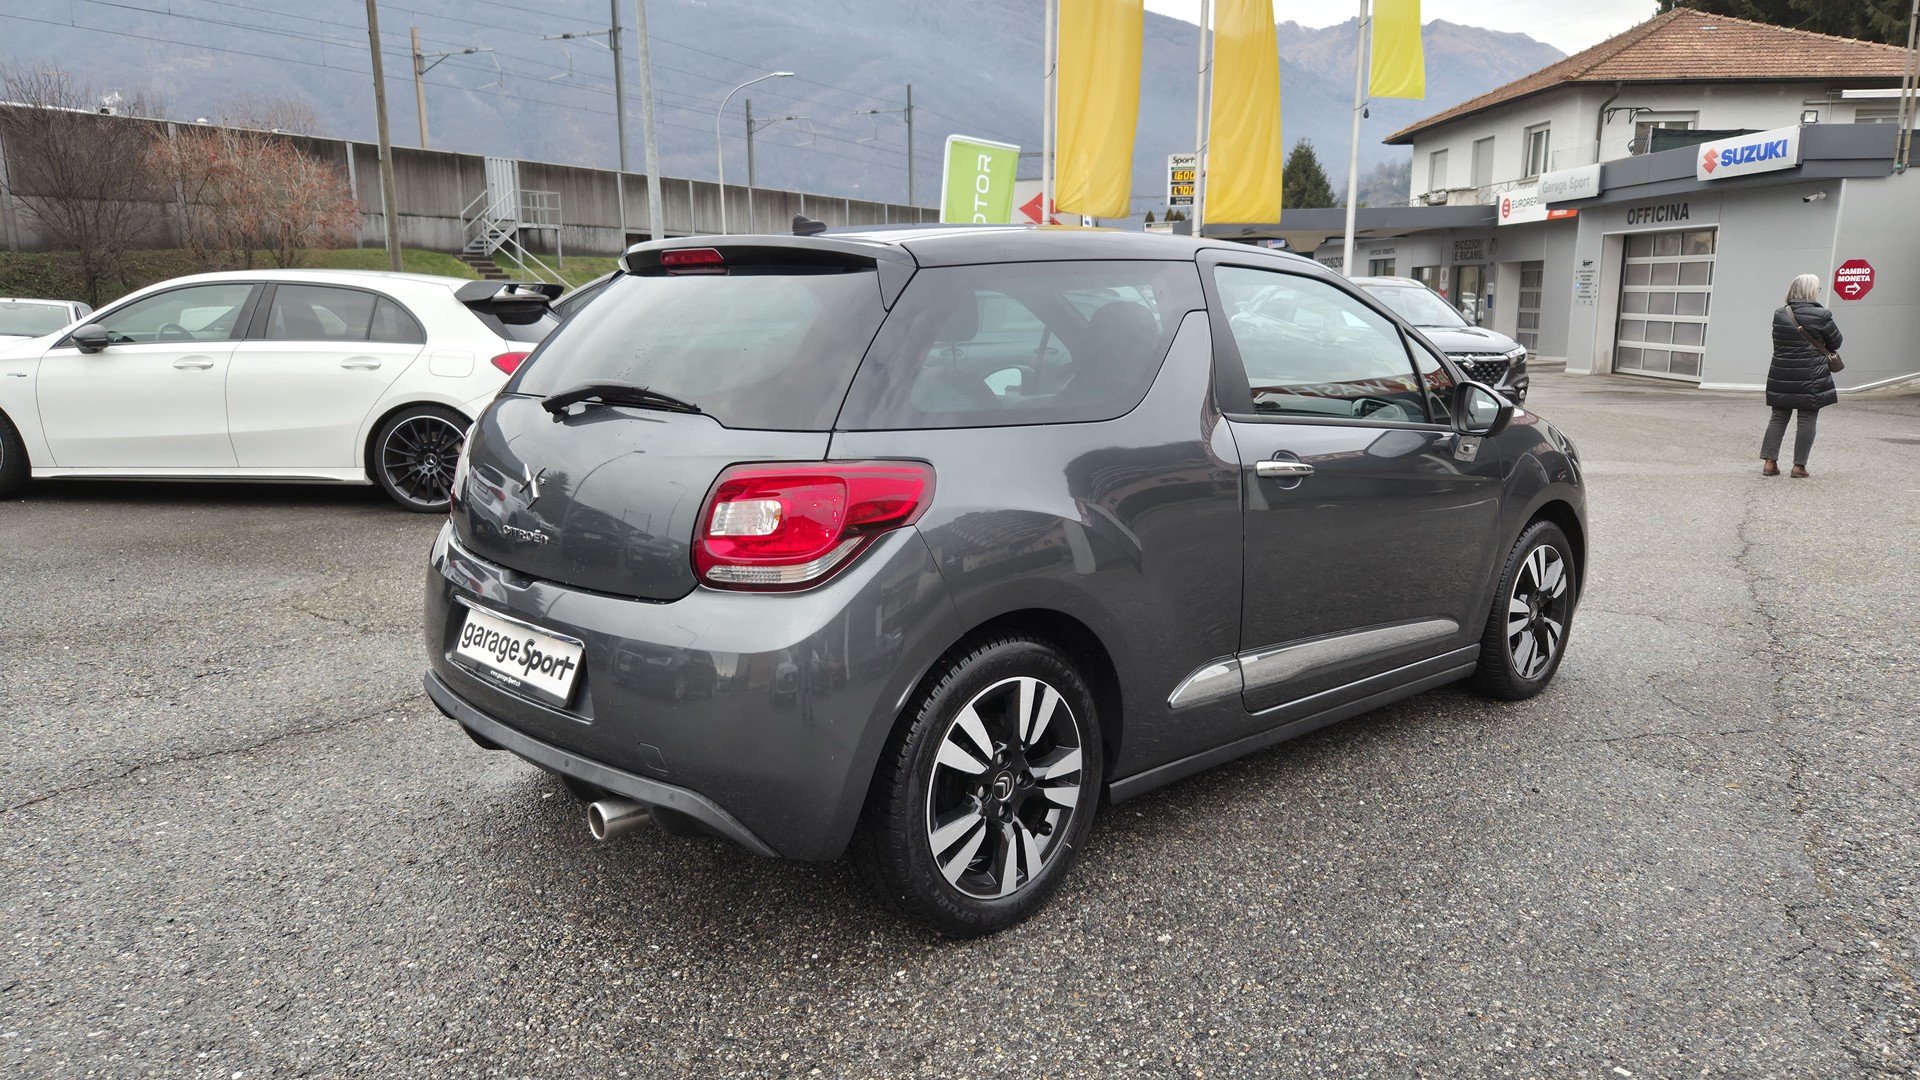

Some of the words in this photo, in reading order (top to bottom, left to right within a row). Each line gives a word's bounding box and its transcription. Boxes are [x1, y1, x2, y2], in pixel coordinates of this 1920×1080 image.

[1172, 156, 1196, 166] Sport
[1721, 139, 1788, 167] SUZUKI
[1543, 181, 1567, 194] Garage
[1569, 176, 1590, 191] Sport
[1627, 203, 1690, 225] OFFICINA
[1839, 267, 1871, 275] CAMBIO
